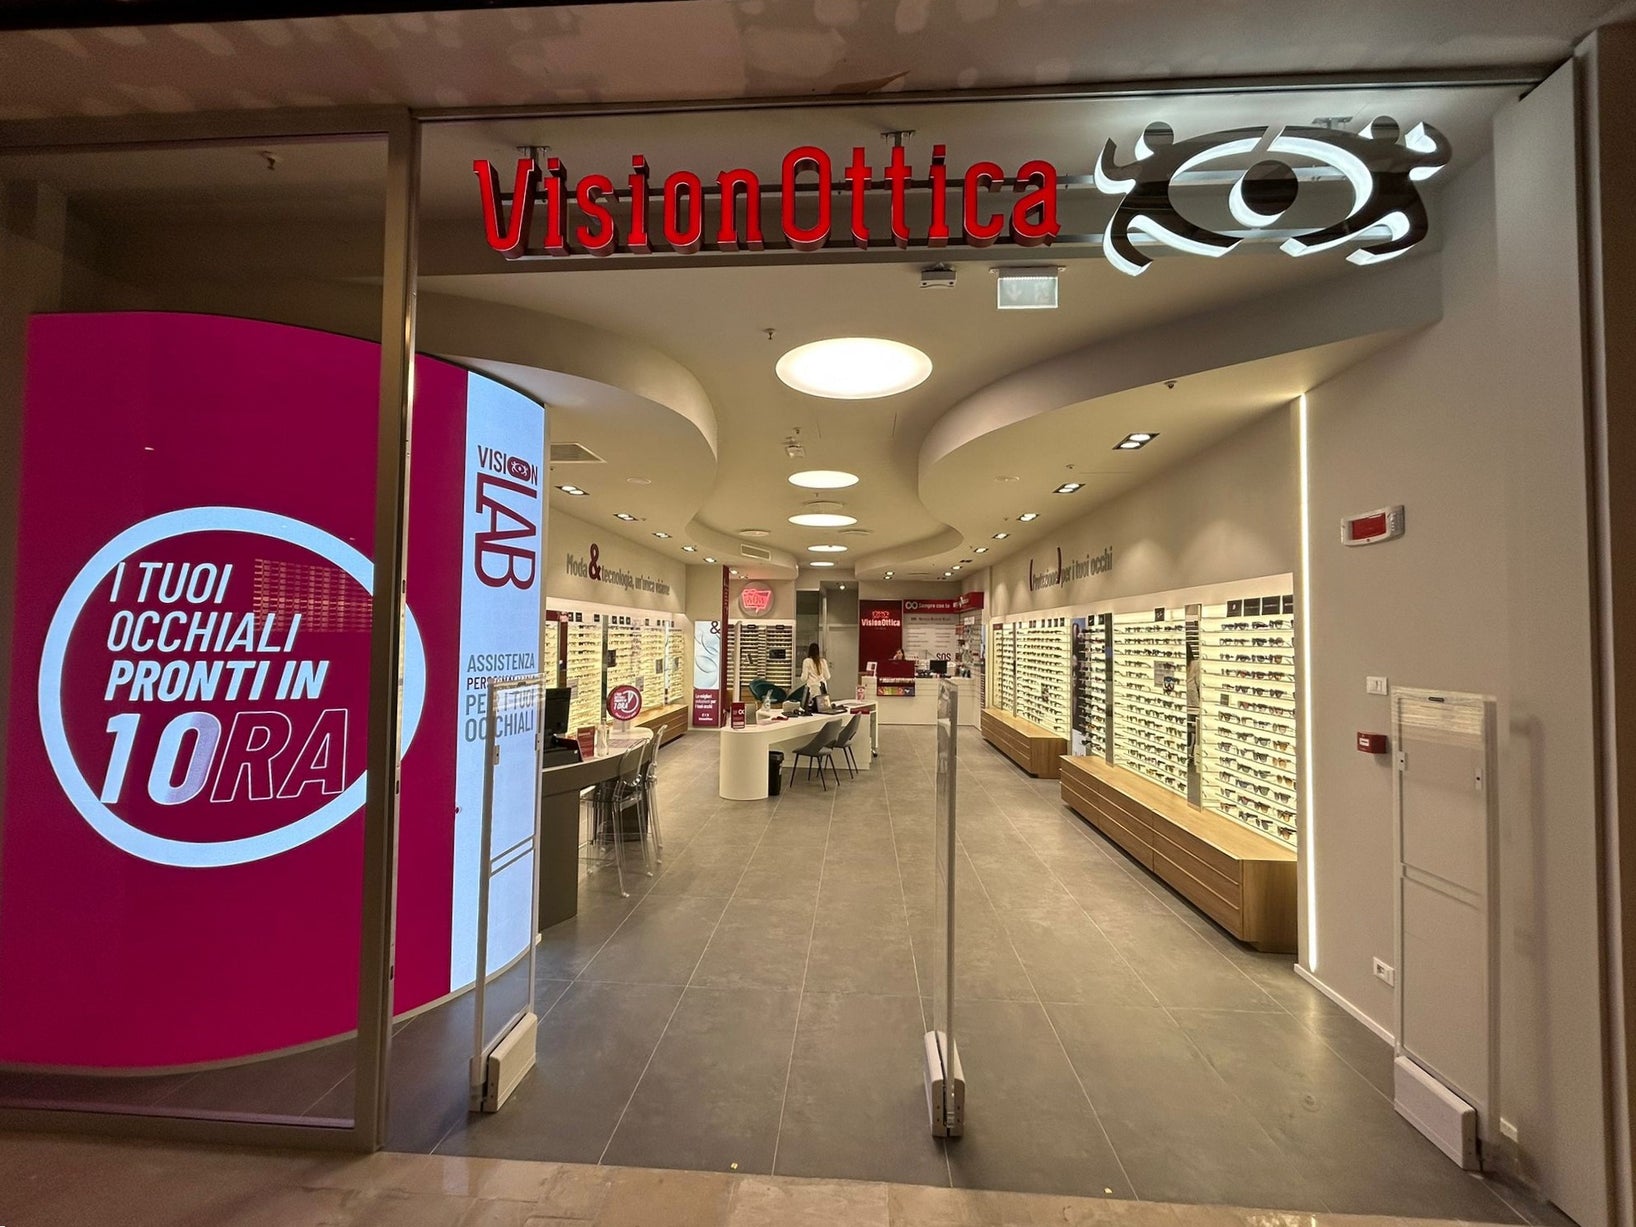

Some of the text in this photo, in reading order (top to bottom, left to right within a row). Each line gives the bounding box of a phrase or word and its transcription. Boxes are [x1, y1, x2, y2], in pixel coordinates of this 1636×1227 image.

[473, 144, 1061, 256] VisionOttica
[474, 472, 538, 590] LAB
[566, 553, 587, 578] Moda
[589, 543, 601, 580] &
[1090, 546, 1113, 576] occhi
[109, 562, 234, 604] I TUOI
[107, 610, 302, 653] OCCHIALI
[861, 618, 901, 627] VisionOttica
[104, 659, 330, 702] PRONTI IN
[467, 653, 535, 673] ASSISTENZA
